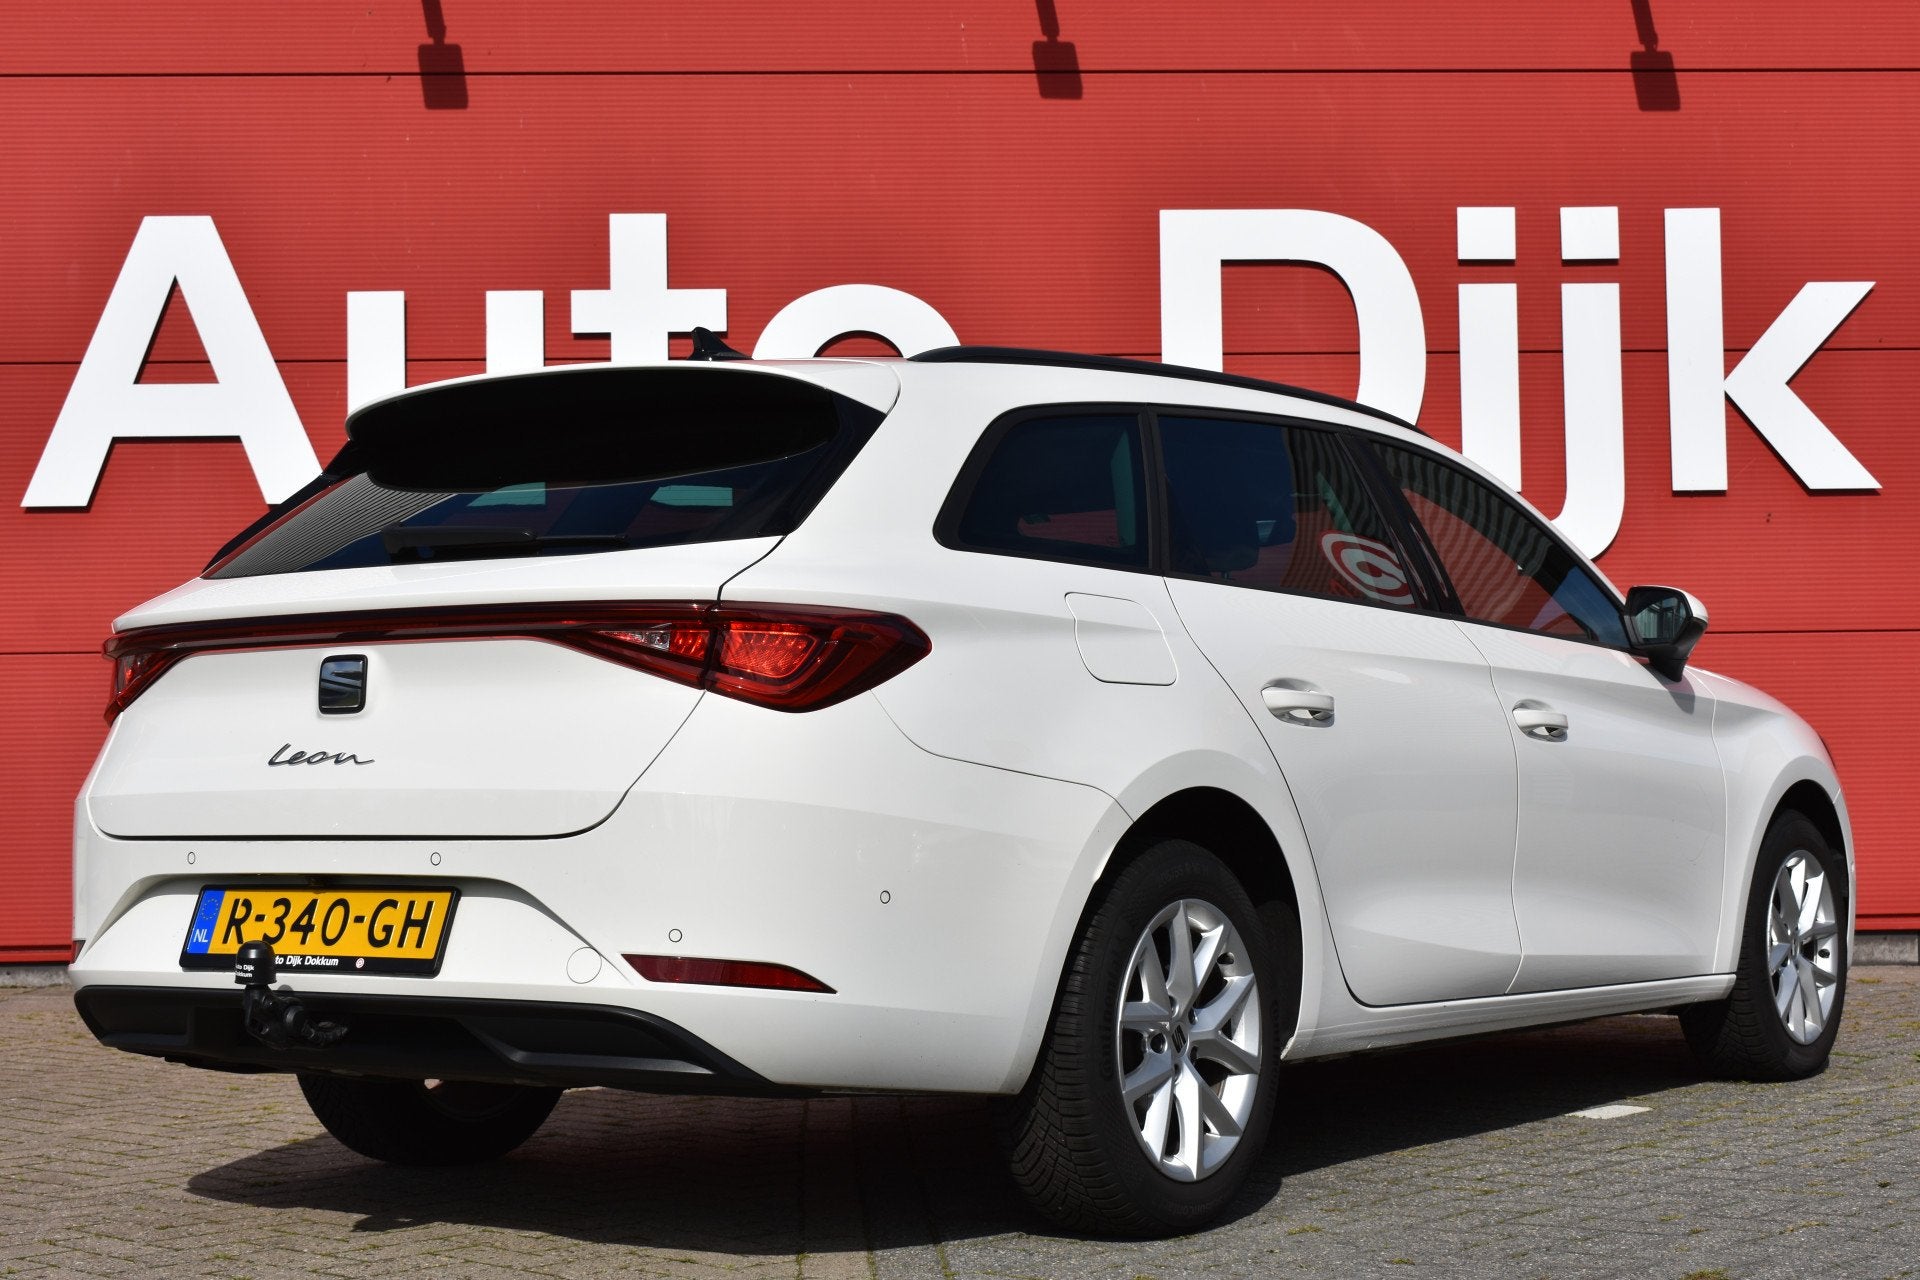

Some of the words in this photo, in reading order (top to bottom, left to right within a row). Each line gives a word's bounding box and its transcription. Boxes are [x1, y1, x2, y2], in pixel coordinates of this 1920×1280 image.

[1159, 206, 1881, 558] Dijk
[268, 742, 375, 766] Leon
[222, 897, 435, 948] R-340-GH
[193, 928, 208, 943] NL
[274, 955, 284, 965] to
[286, 955, 303, 967] Dijk
[304, 955, 339, 966] Dokkum
